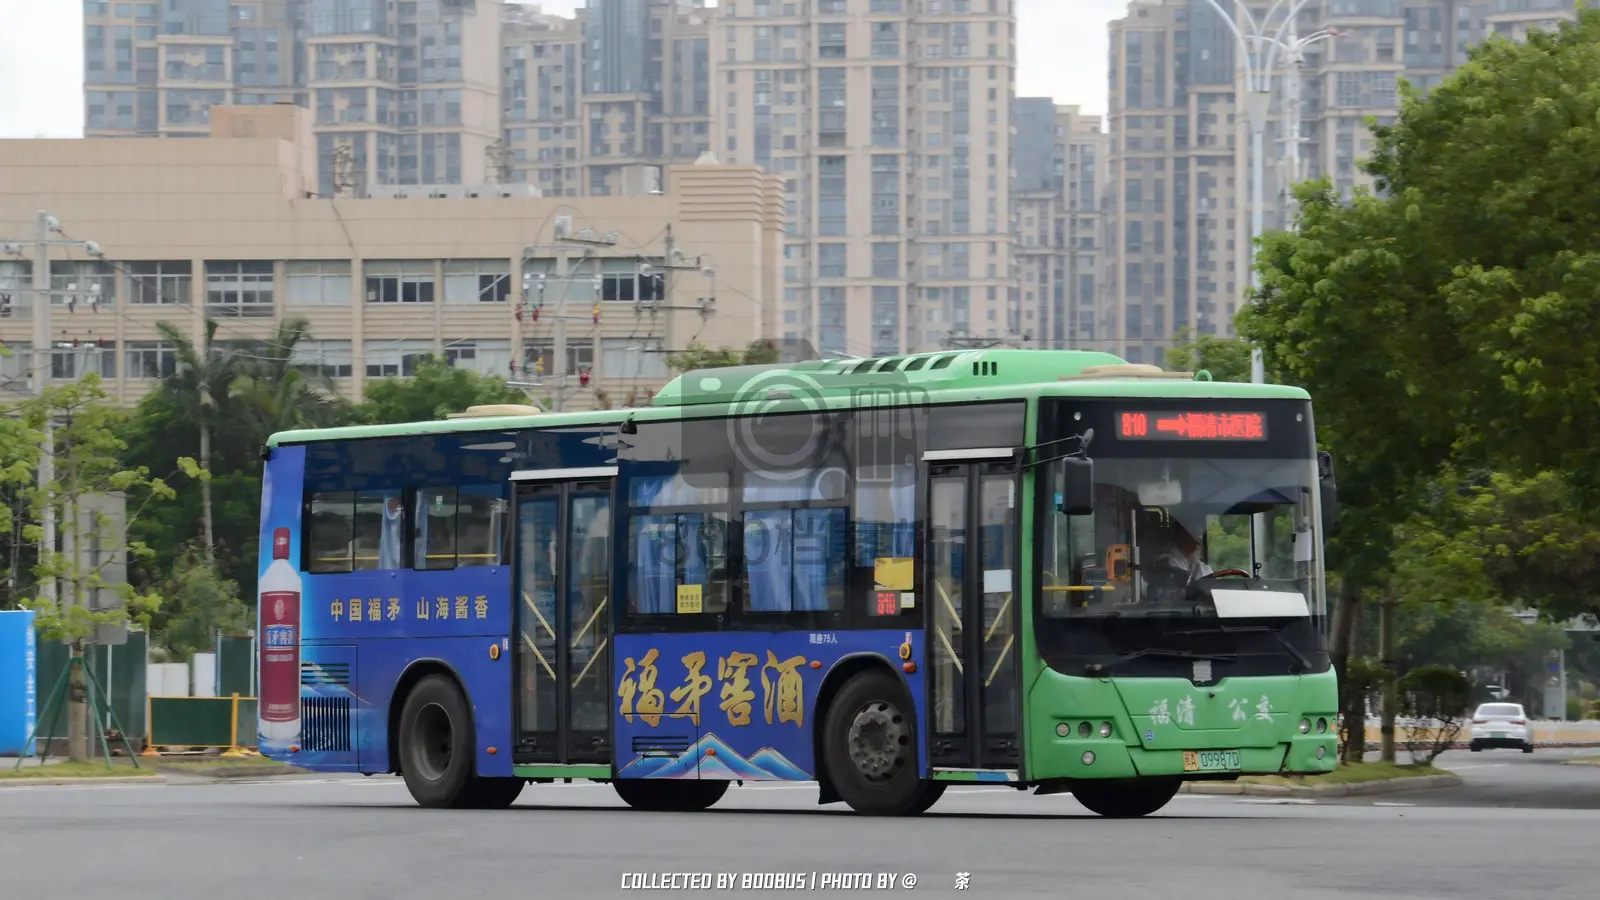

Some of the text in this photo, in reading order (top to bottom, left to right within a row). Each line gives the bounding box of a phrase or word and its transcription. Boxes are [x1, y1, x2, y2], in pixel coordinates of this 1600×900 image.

[330, 595, 489, 622] 中国福矛 山海酱香
[618, 648, 807, 728] 福矛窖酒
[1148, 694, 1274, 727] 福清 公交
